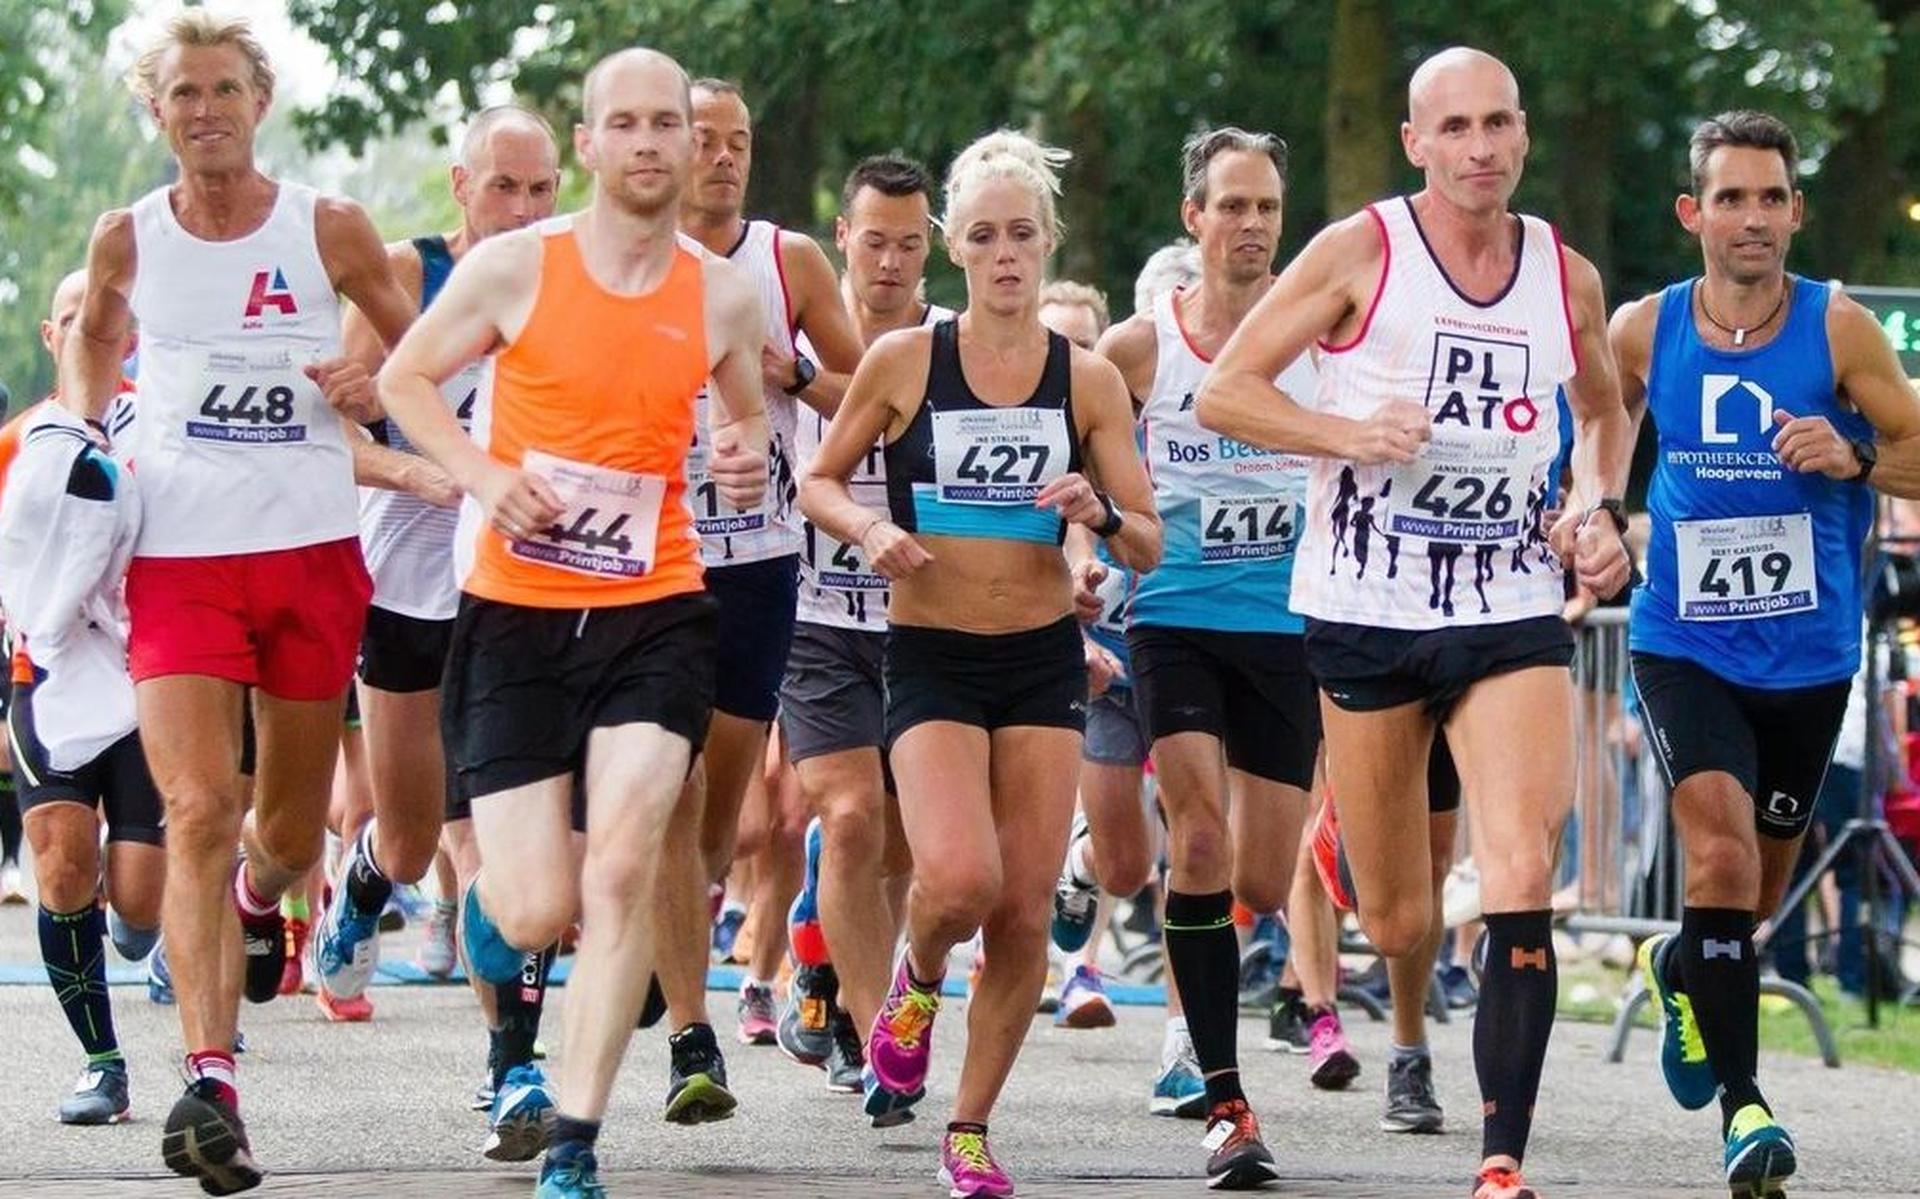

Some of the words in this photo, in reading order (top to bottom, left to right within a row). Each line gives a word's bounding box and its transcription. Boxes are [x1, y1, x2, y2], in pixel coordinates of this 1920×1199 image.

[200, 384, 295, 425] 448
[956, 444, 1050, 484] 427
[1167, 440, 1210, 463] Bos
[1695, 467, 1782, 481] Hoogeveen
[1411, 474, 1513, 520] 426
[1205, 505, 1293, 543] 414
[1400, 520, 1516, 541] www.Printjob.nl
[1699, 551, 1792, 597] 419
[1692, 594, 1805, 614] www.Printjob.nl
